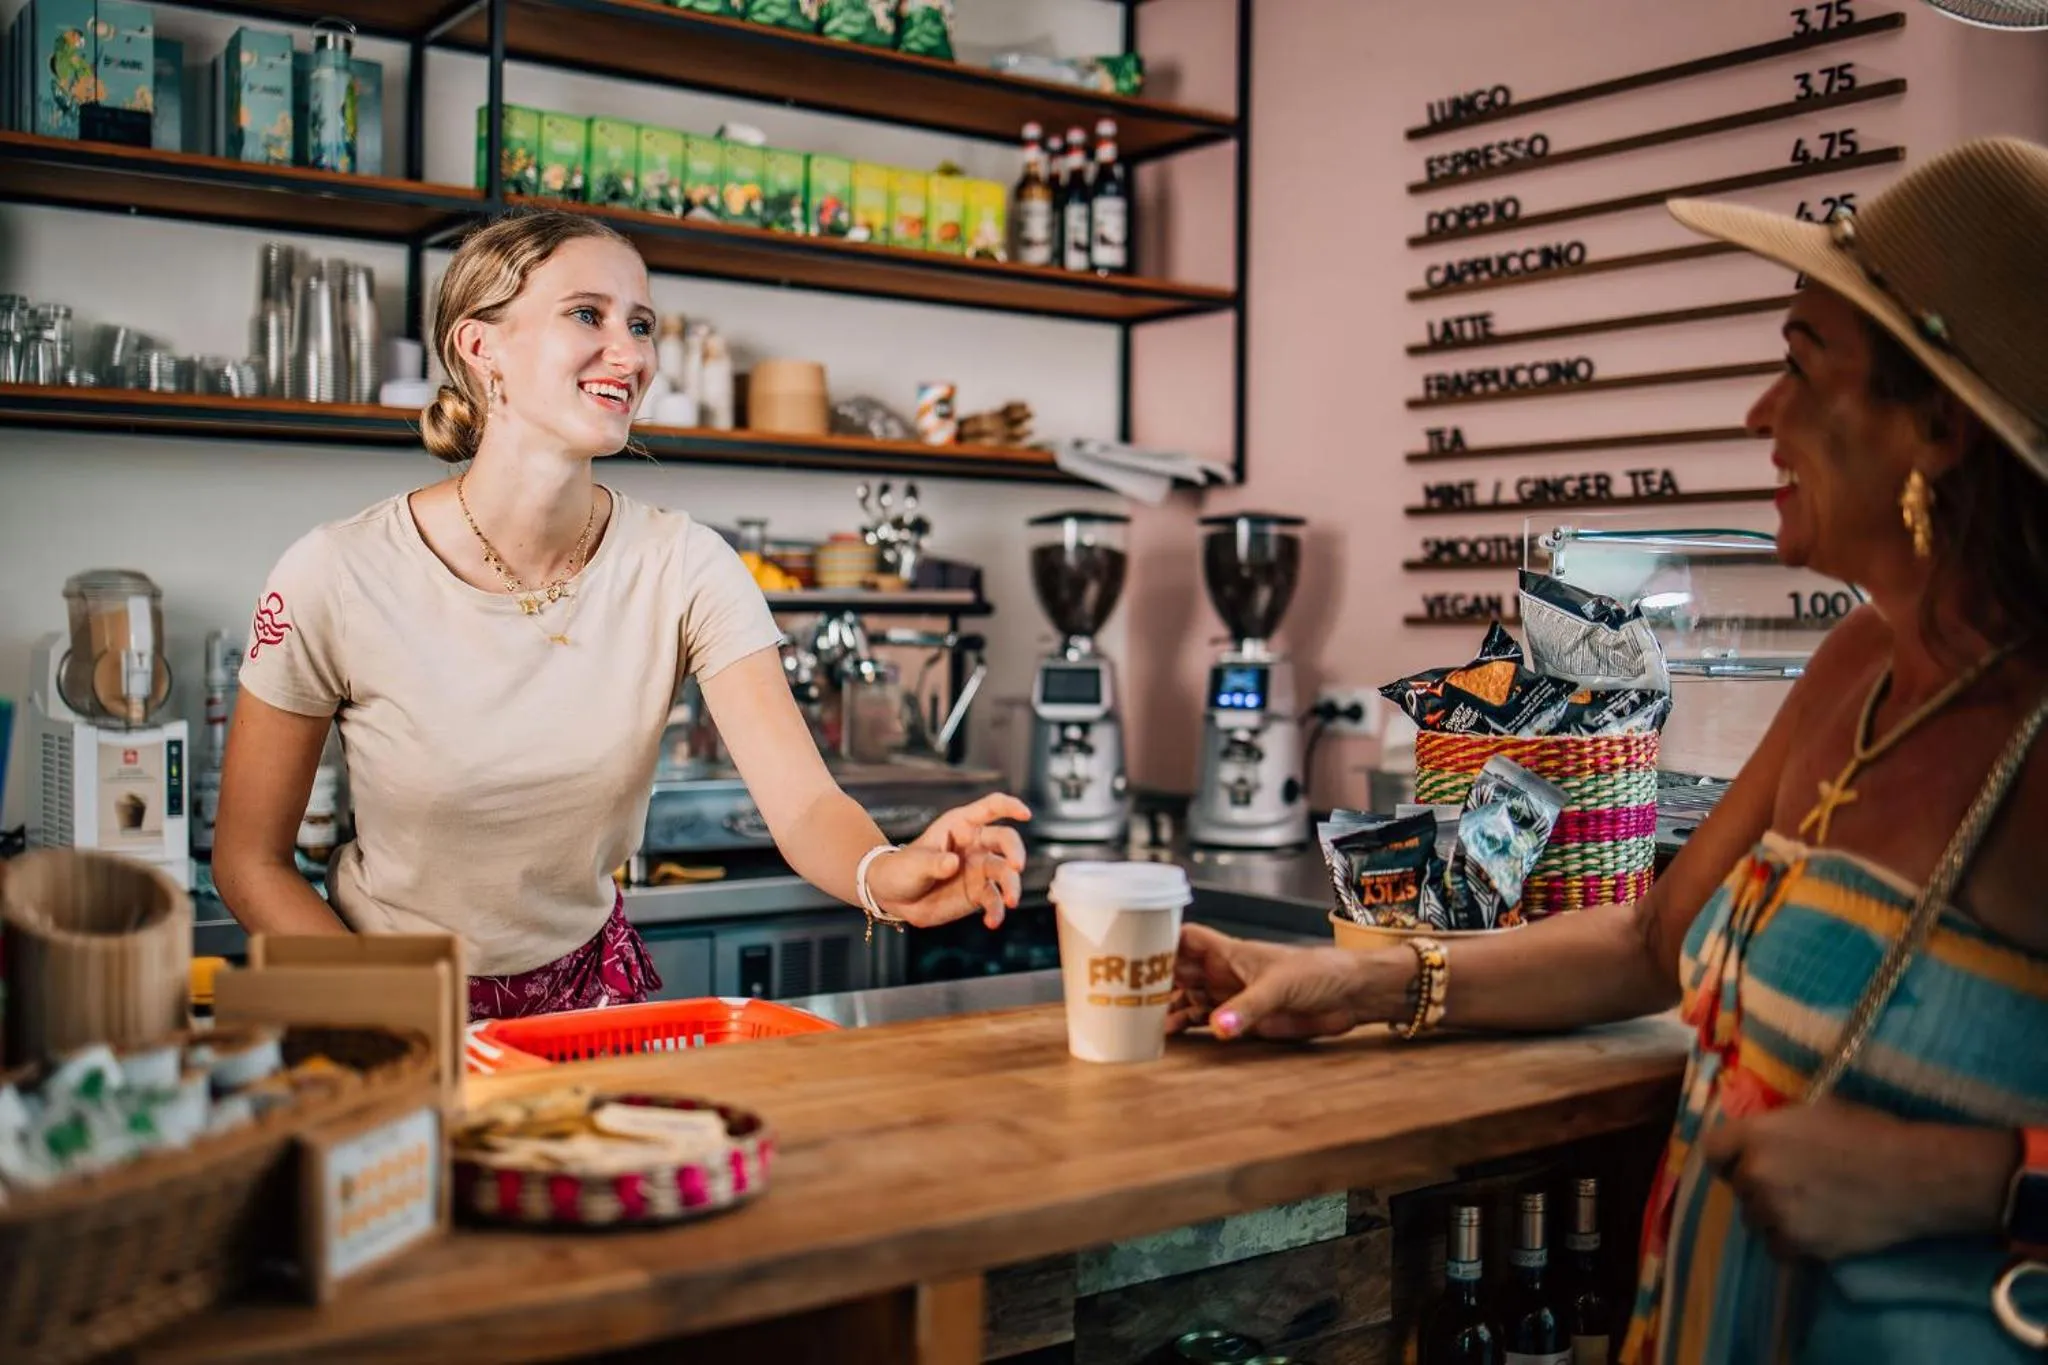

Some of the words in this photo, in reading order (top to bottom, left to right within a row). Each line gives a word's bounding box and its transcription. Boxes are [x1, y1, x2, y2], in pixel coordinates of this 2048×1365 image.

[1427, 84, 1511, 127] LUNGO
[1790, 0, 1855, 36] 3.75
[1425, 133, 1549, 182] ESPRESSO
[1794, 63, 1857, 100] 3.75
[1426, 196, 1520, 236] DOPPIO
[1791, 128, 1858, 164] 4.75
[1425, 241, 1587, 290] CAPPUCCINO
[1427, 310, 1495, 346] LATTE
[1424, 356, 1595, 399] FRAPPUCCINO
[1425, 427, 1467, 452] TEA
[1424, 481, 1477, 507] MINT
[1491, 479, 1502, 505] /
[1515, 471, 1613, 503] GINGER
[1625, 469, 1681, 499] TEA
[1421, 593, 1502, 619] VEGAN
[1787, 591, 1852, 619] 1.00
